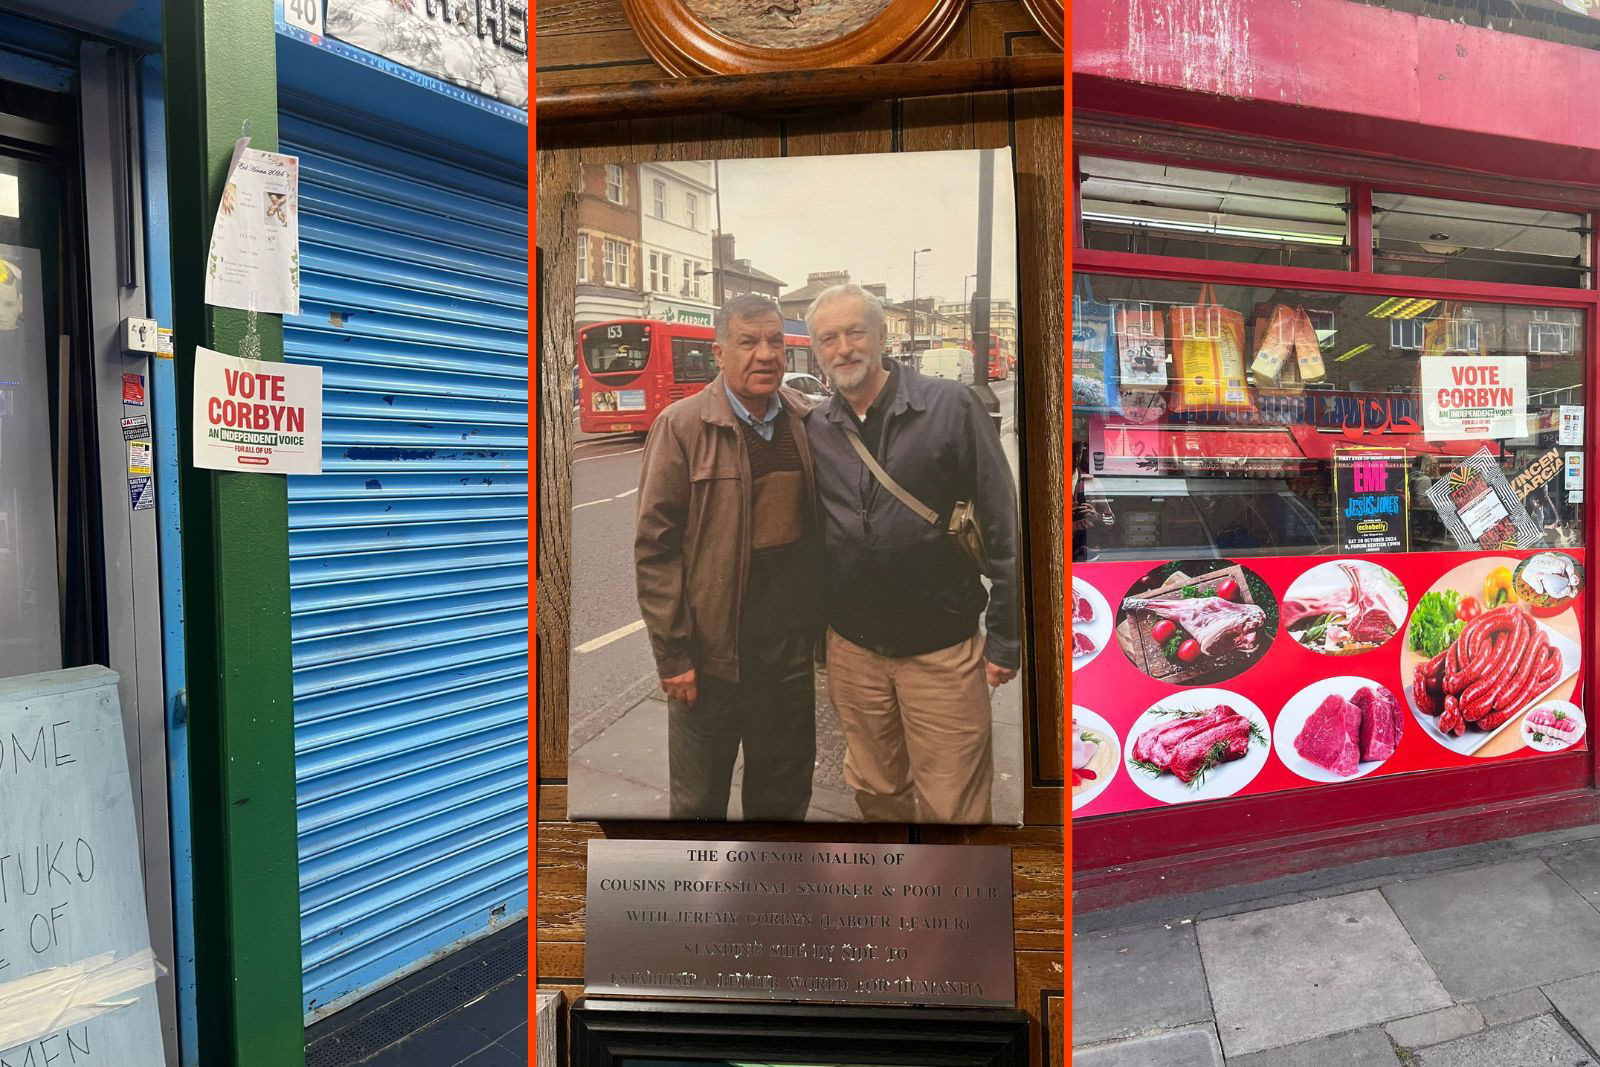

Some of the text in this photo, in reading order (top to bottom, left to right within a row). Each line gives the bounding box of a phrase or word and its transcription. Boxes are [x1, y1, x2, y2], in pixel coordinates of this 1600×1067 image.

[290, 0, 316, 25] 40
[608, 325, 622, 339] 153
[224, 368, 285, 402] VOTE
[1451, 366, 1500, 386] VOTE
[1437, 388, 1513, 408] CORBYN
[208, 396, 305, 433] CORBYN
[1449, 409, 1494, 419] INDEPENDENT
[1495, 409, 1513, 417] VOICE
[208, 428, 305, 446] AN INDEPENDENT VOICE
[234, 445, 244, 453] FOR
[244, 446, 255, 454] ALL
[264, 447, 272, 455] US
[1354, 461, 1388, 492] EMF
[1358, 522, 1386, 531] echobelly
[0, 720, 76, 774] ME
[687, 849, 905, 866] THE GOVENOR (MALIK) OF
[600, 879, 666, 891] COUSINS
[674, 880, 787, 894] PROFESSIONAL
[797, 883, 873, 897] SNOOKER
[881, 885, 895, 896] &
[954, 886, 1000, 899] CLUB
[30, 902, 68, 954] OF
[627, 910, 970, 931] WITH JEREMY CORBYN (LABOUR LEADER)
[684, 942, 909, 961] STANDING SIDE BY SIDE TO
[703, 975, 712, 986] A
[717, 972, 780, 989] BETTER
[788, 977, 848, 991] WORLD
[856, 979, 889, 993] FOR
[896, 979, 985, 996] HUMANITY
